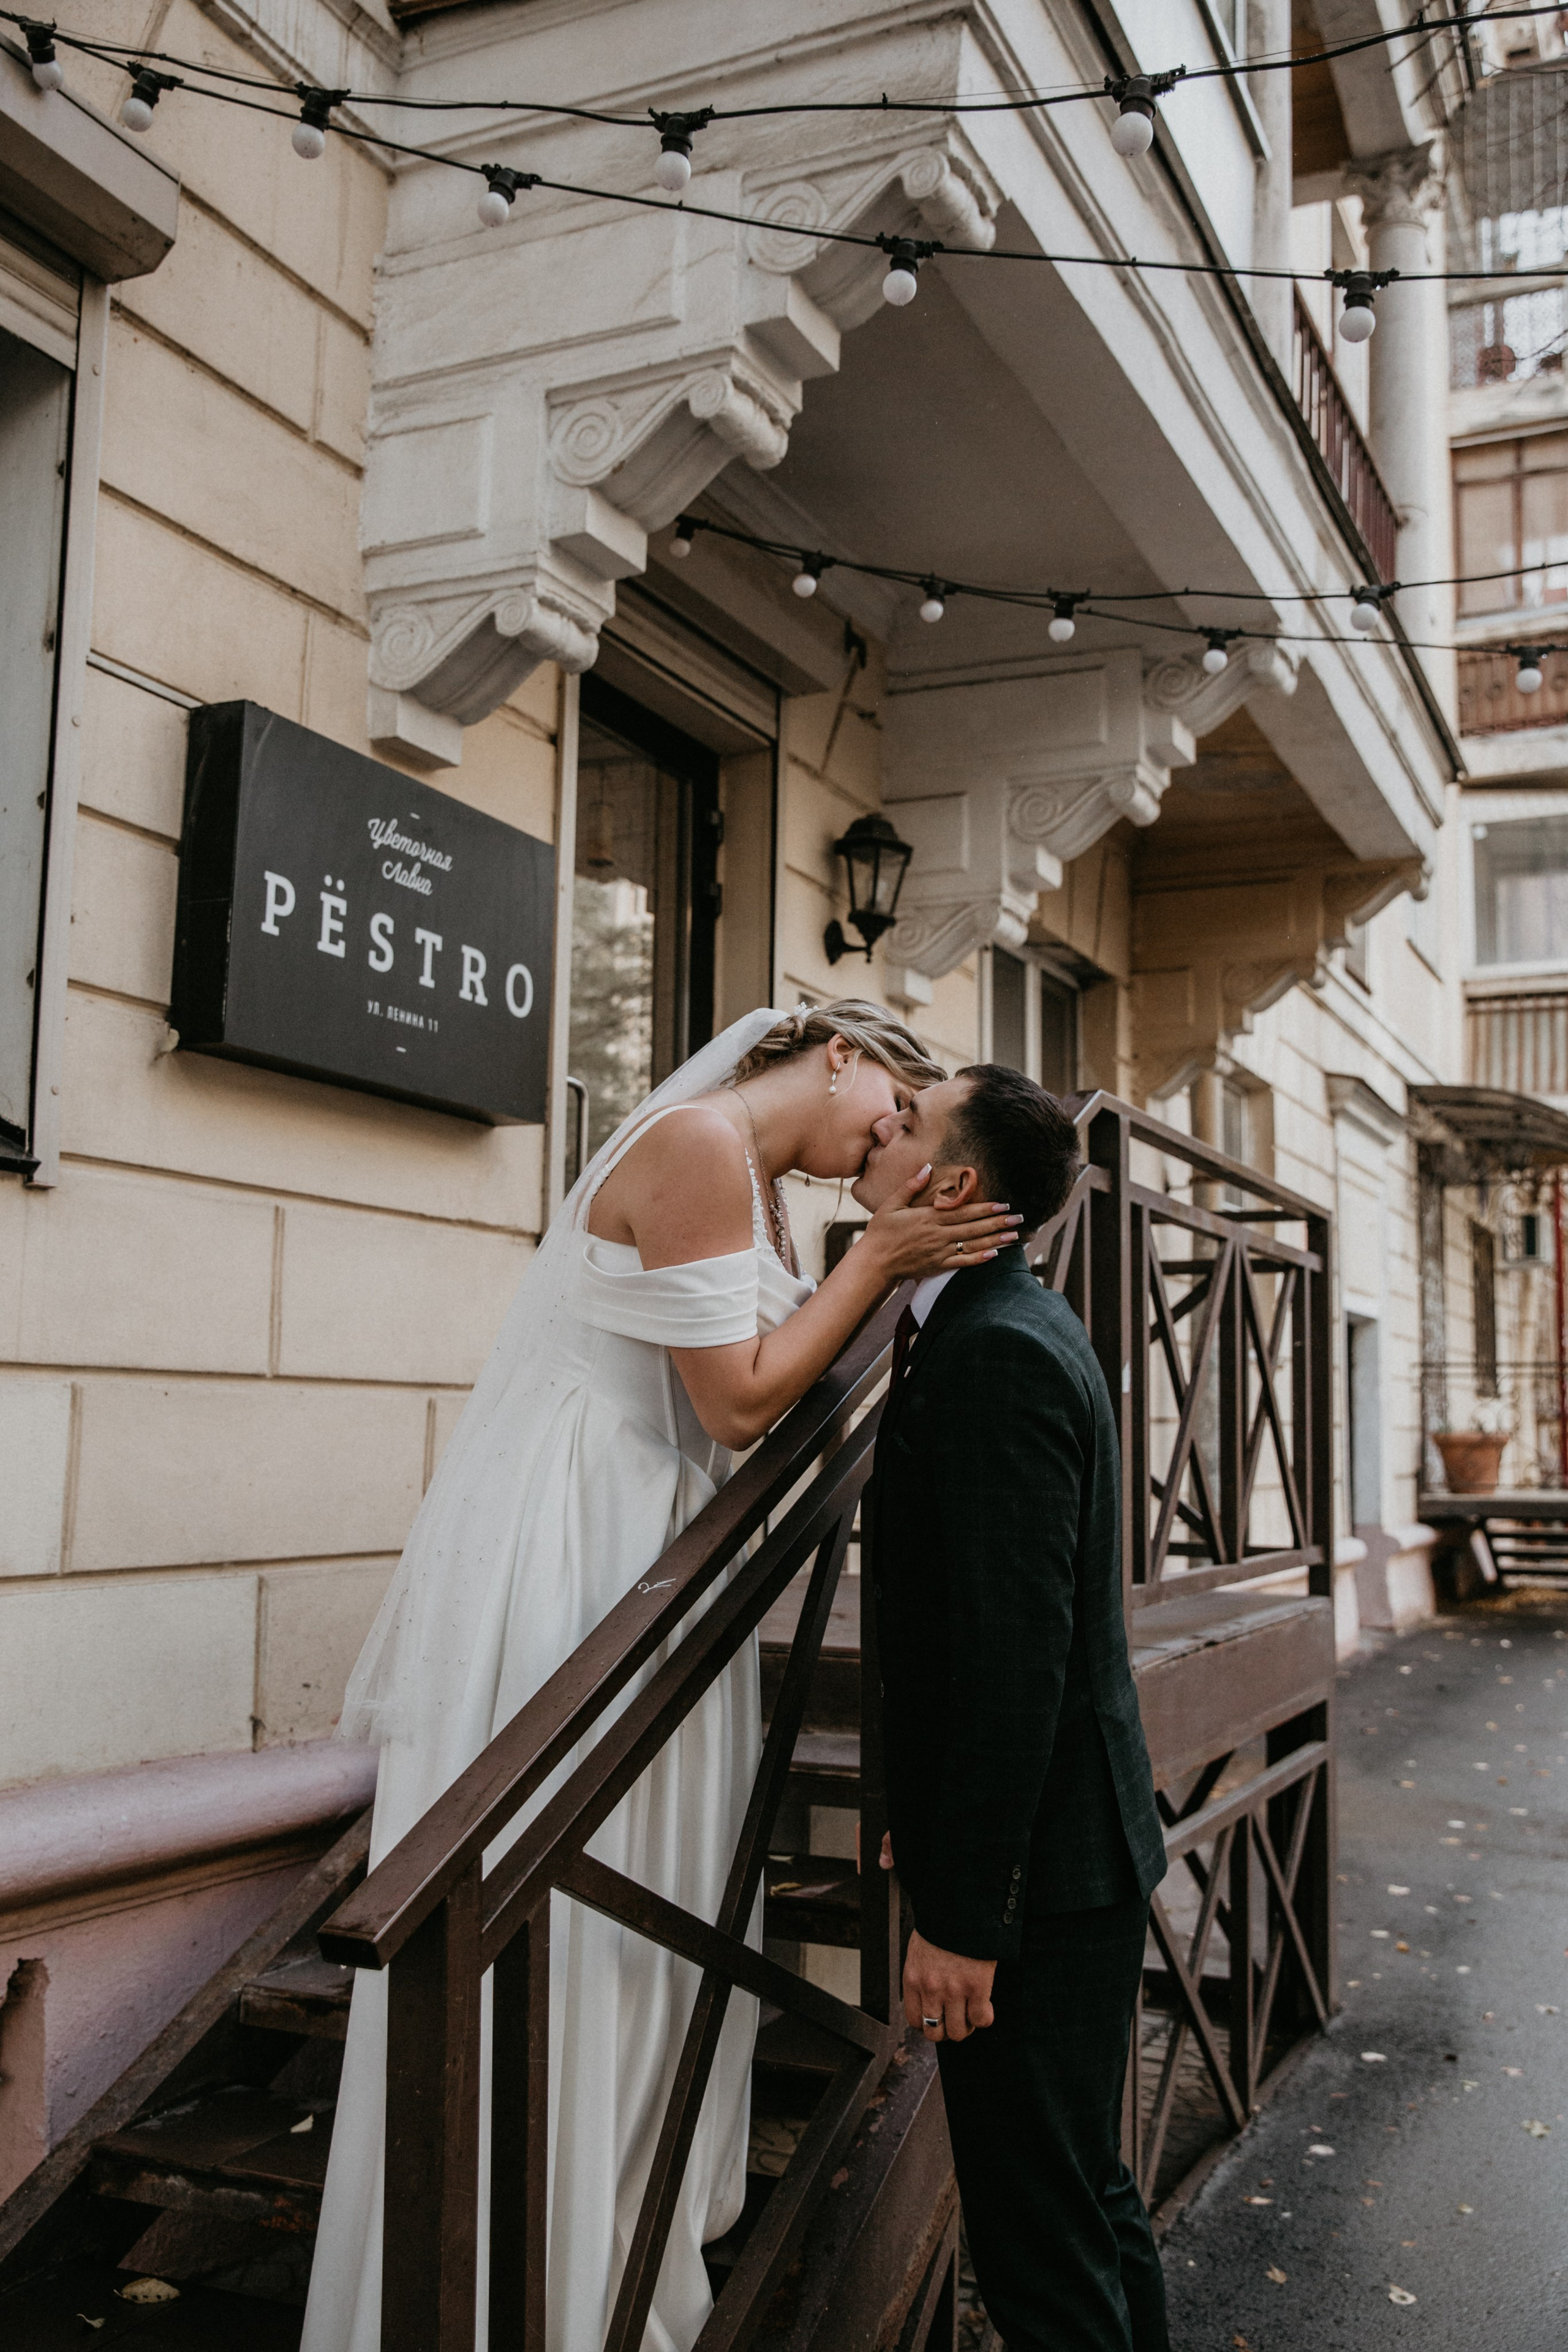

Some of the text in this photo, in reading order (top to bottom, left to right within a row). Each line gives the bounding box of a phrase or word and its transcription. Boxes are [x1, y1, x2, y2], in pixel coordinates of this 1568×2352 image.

[260, 870, 533, 1019] PËSTRO
[386, 1005, 424, 1029] ЛЕНИНА
[428, 1018, 439, 1033] 11
